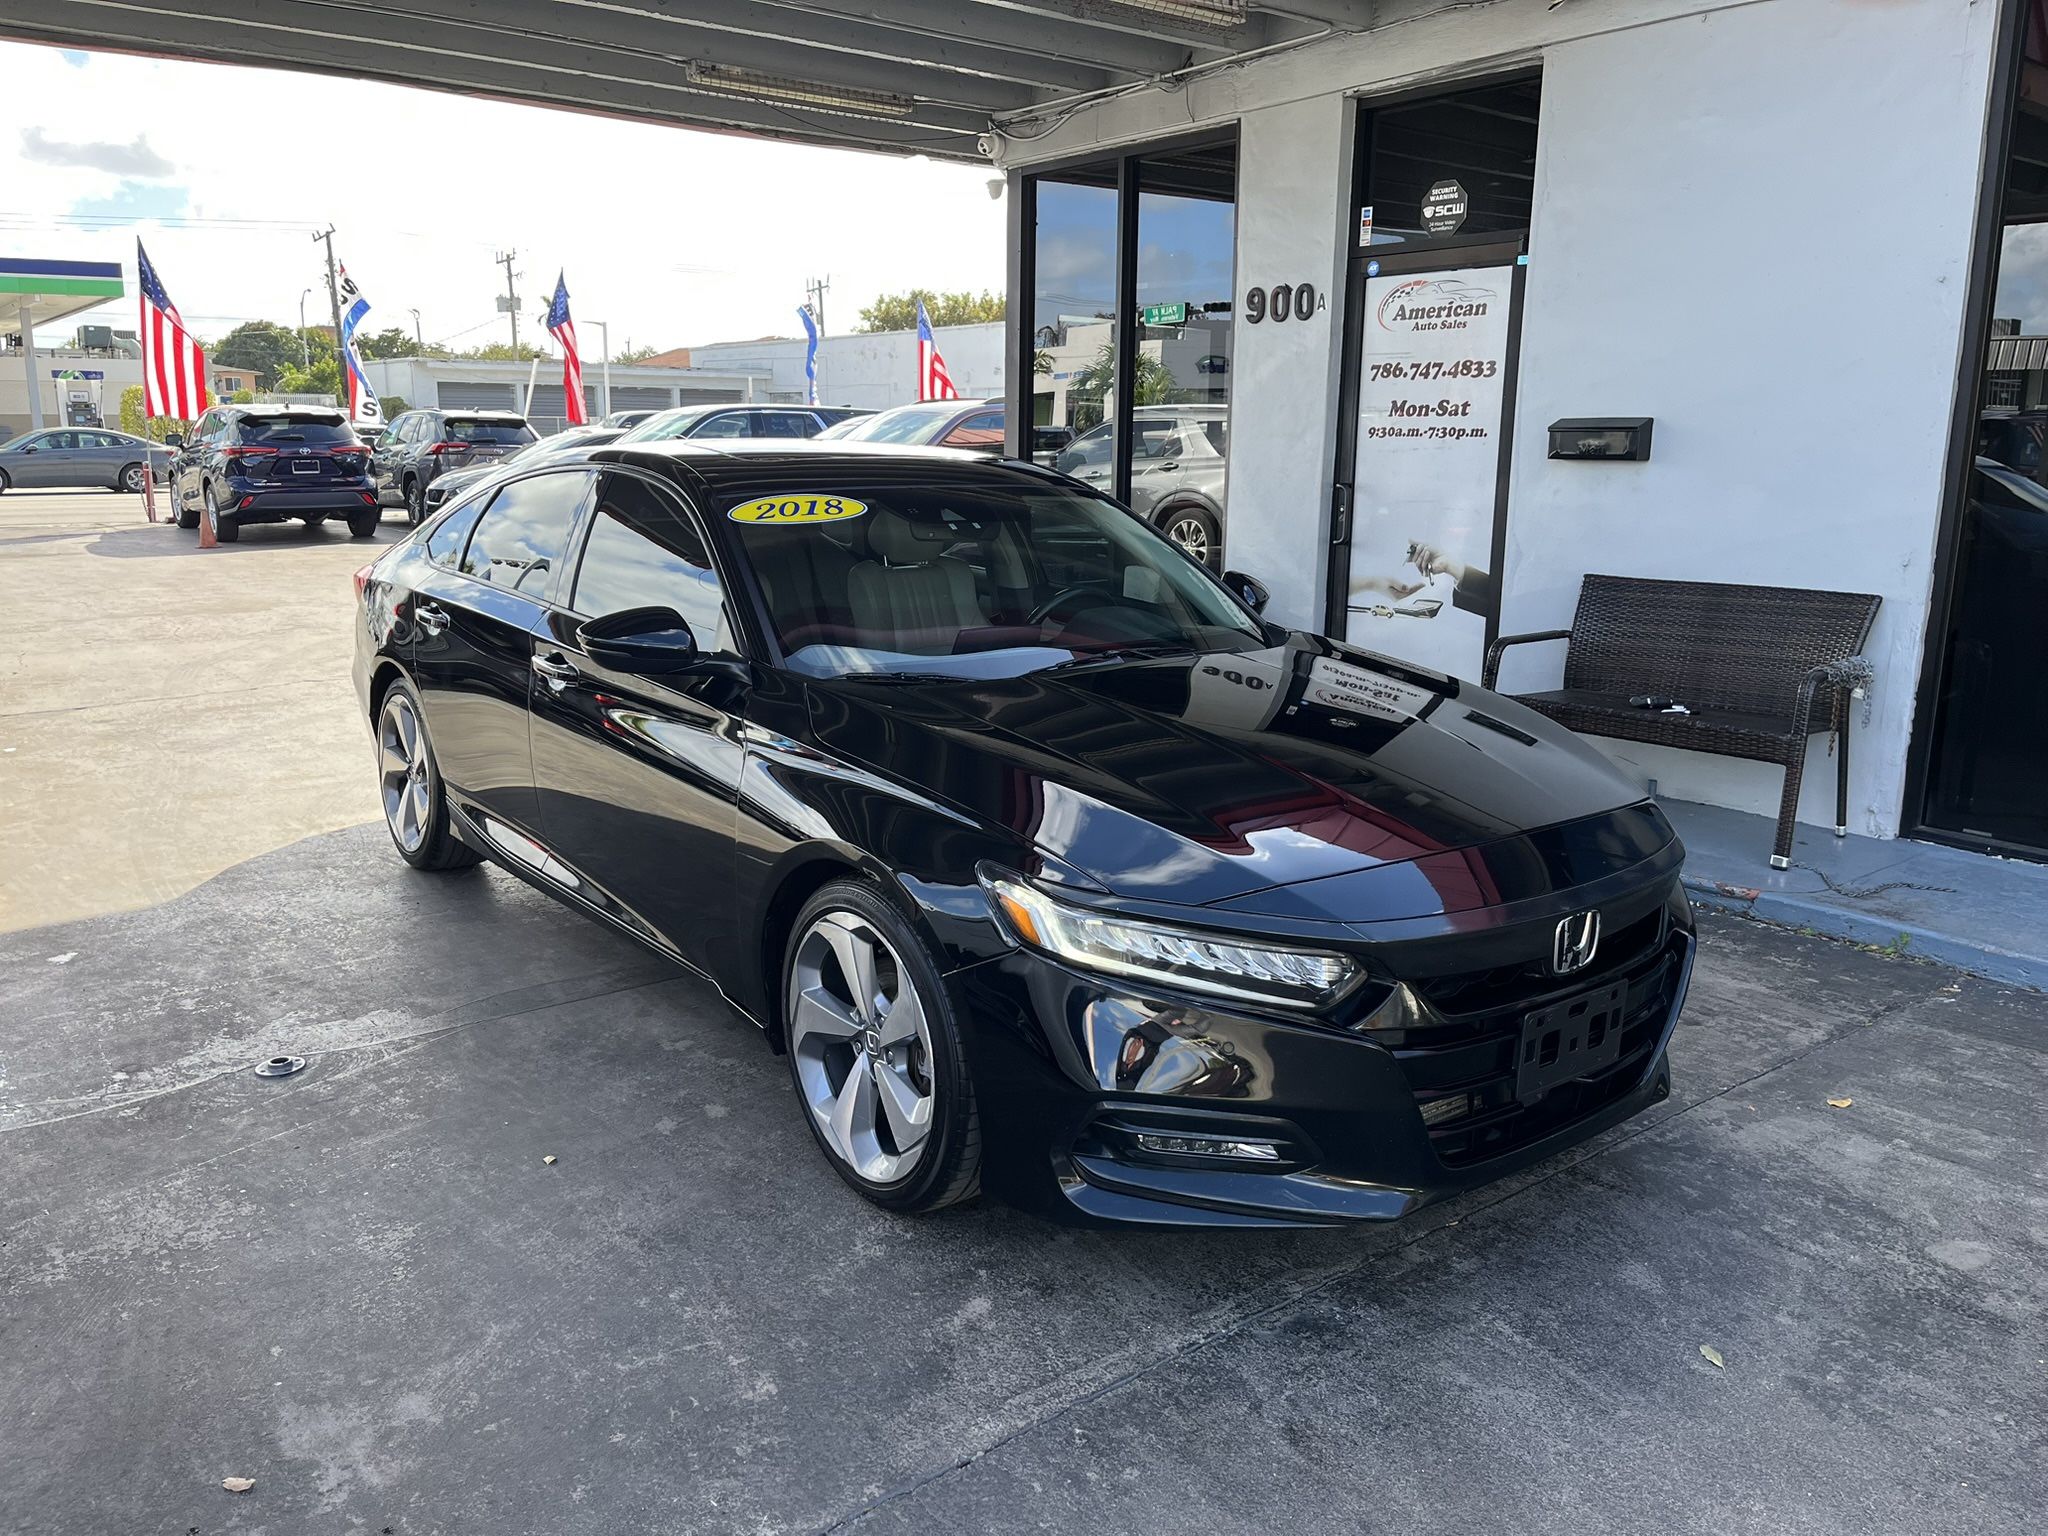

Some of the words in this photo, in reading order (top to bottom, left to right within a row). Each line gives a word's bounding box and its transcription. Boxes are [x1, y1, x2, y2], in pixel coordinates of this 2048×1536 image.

[1429, 192, 1458, 201] WARNING
[1432, 186, 1457, 195] SECURITY
[1435, 203, 1464, 217] SCW
[1392, 301, 1488, 321] American
[1411, 322, 1438, 332] Auto
[1440, 320, 1468, 330] Sales
[1370, 359, 1497, 381] 786.747.4833
[1388, 399, 1472, 417] Mon-Sat
[1368, 426, 1488, 440] 9:30a.m.-7:30p.m.
[755, 499, 844, 520] 2018
